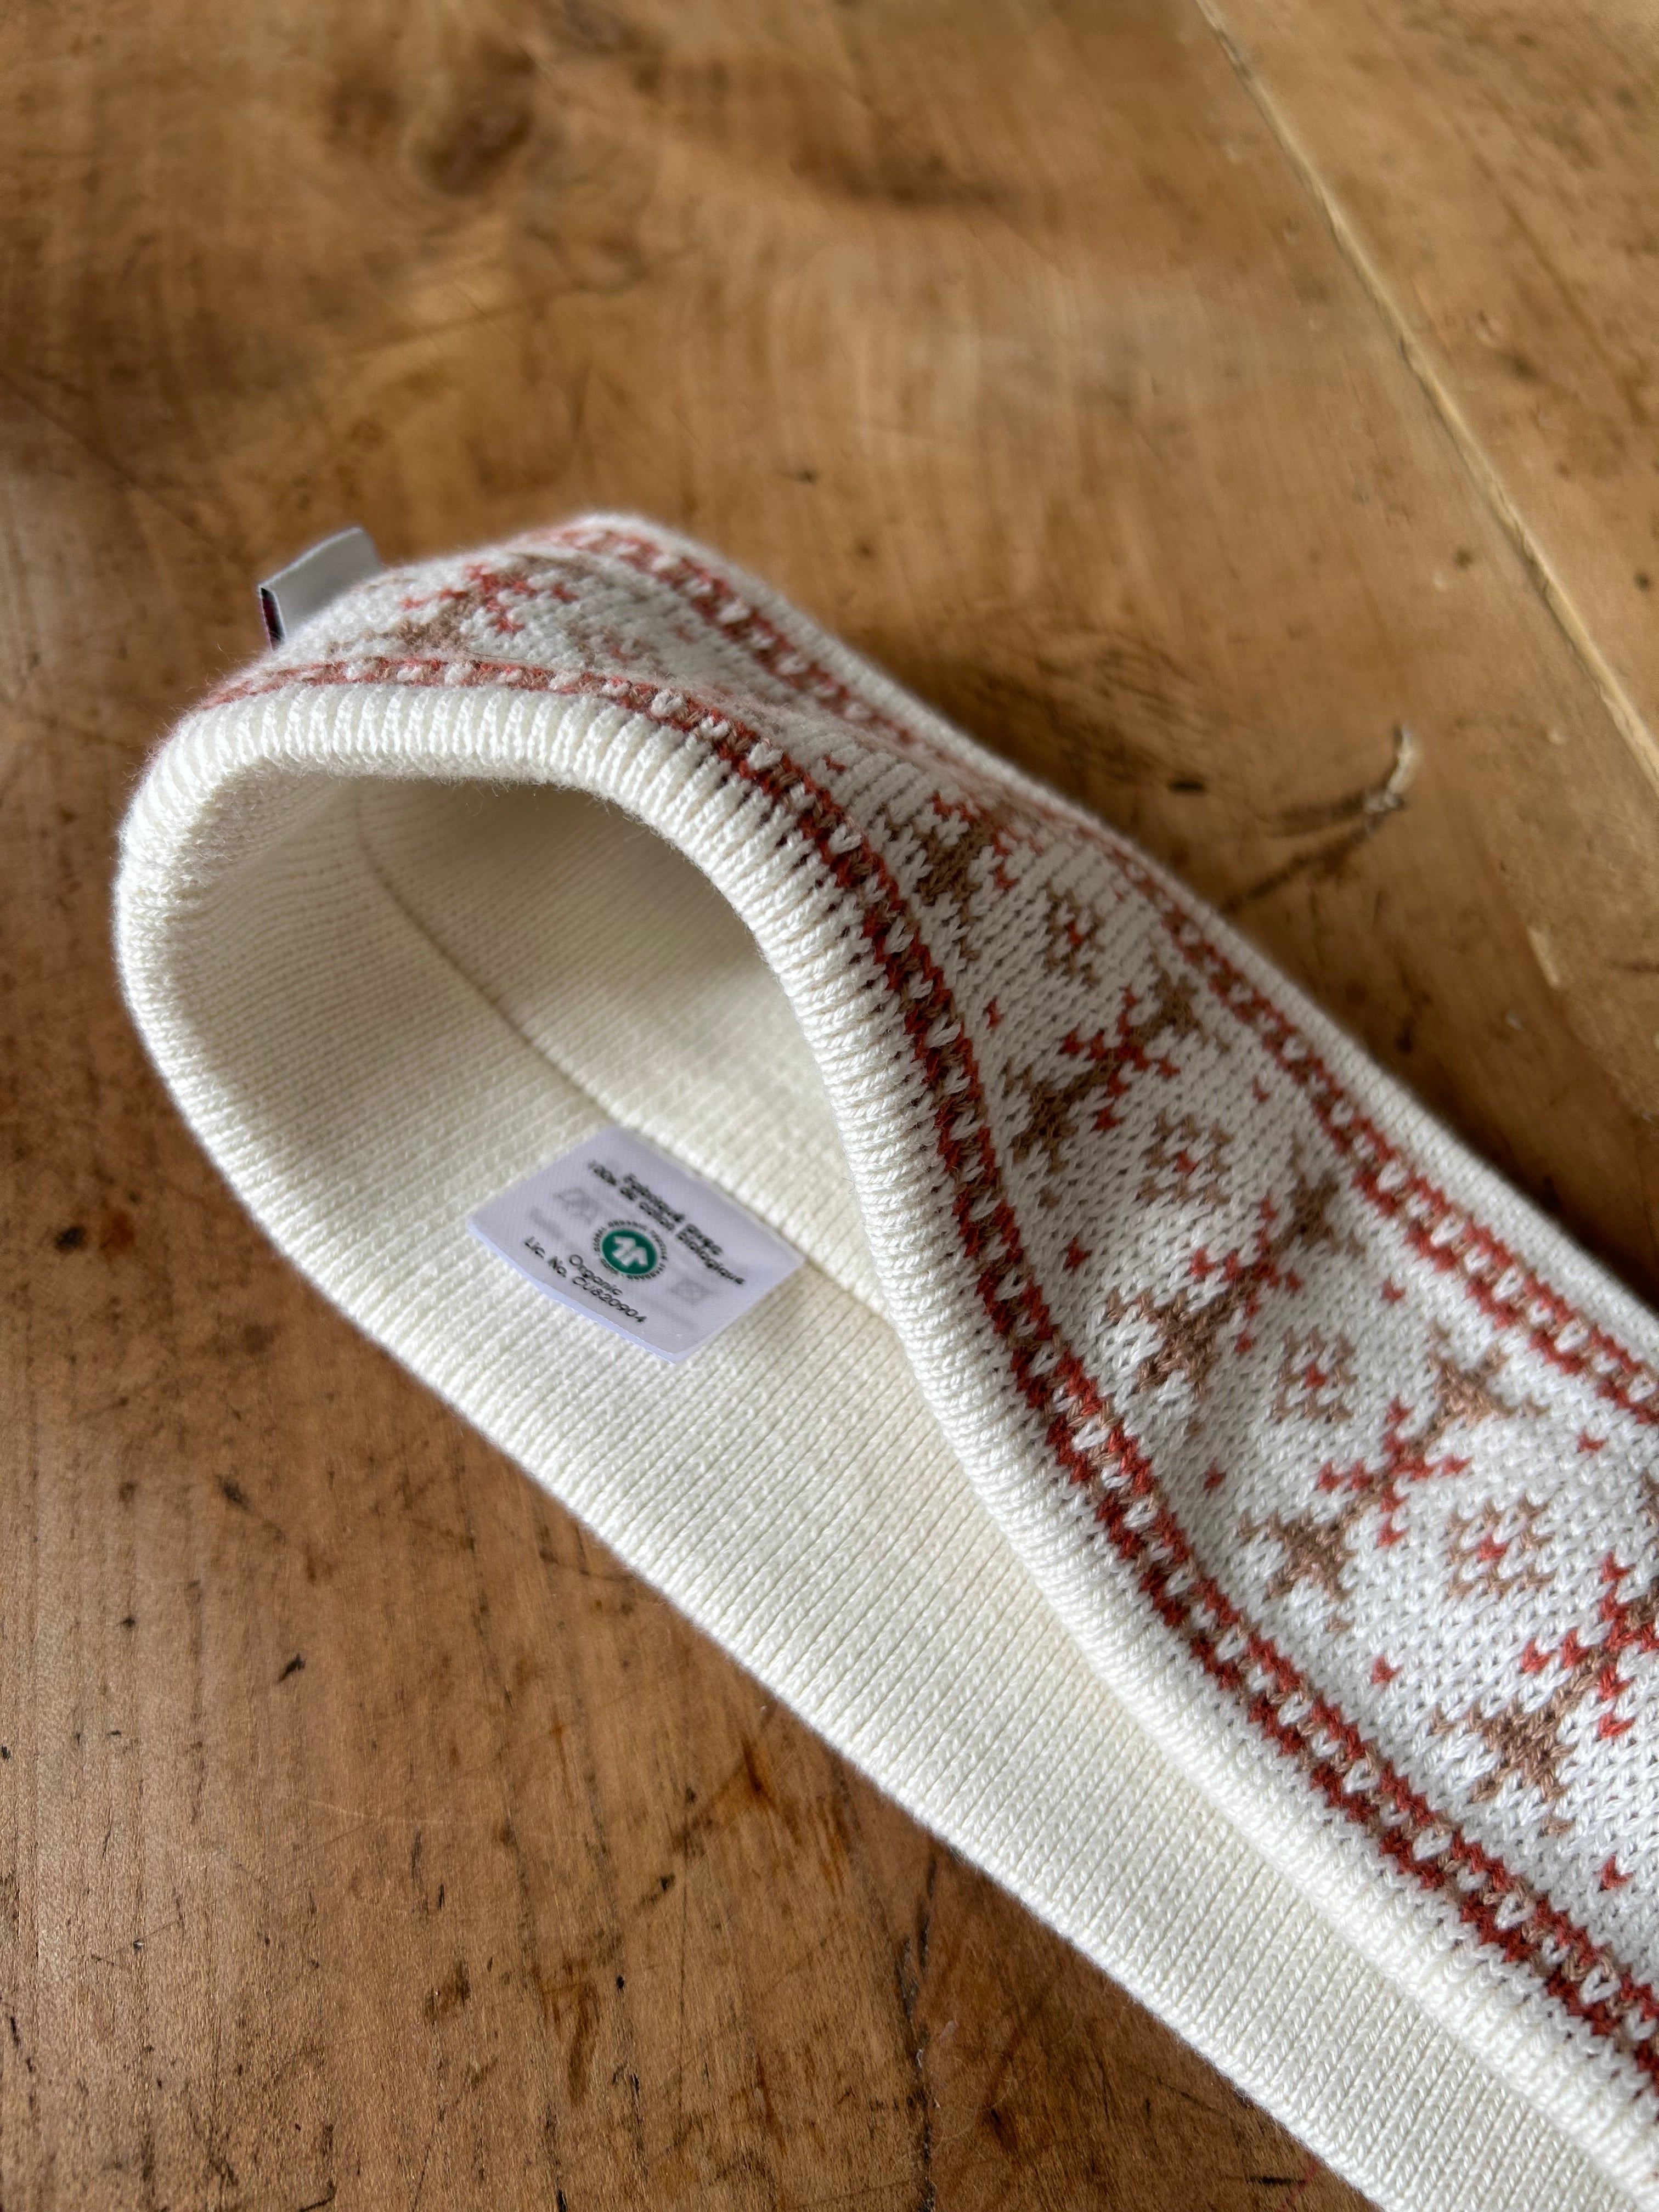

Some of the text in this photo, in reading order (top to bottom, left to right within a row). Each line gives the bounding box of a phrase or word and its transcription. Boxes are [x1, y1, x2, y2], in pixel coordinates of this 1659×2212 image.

[568, 1254, 623, 1296] Organic
[675, 1230, 744, 1284] biologique
[548, 1256, 567, 1278] No.
[572, 1276, 647, 1323] CU820904
